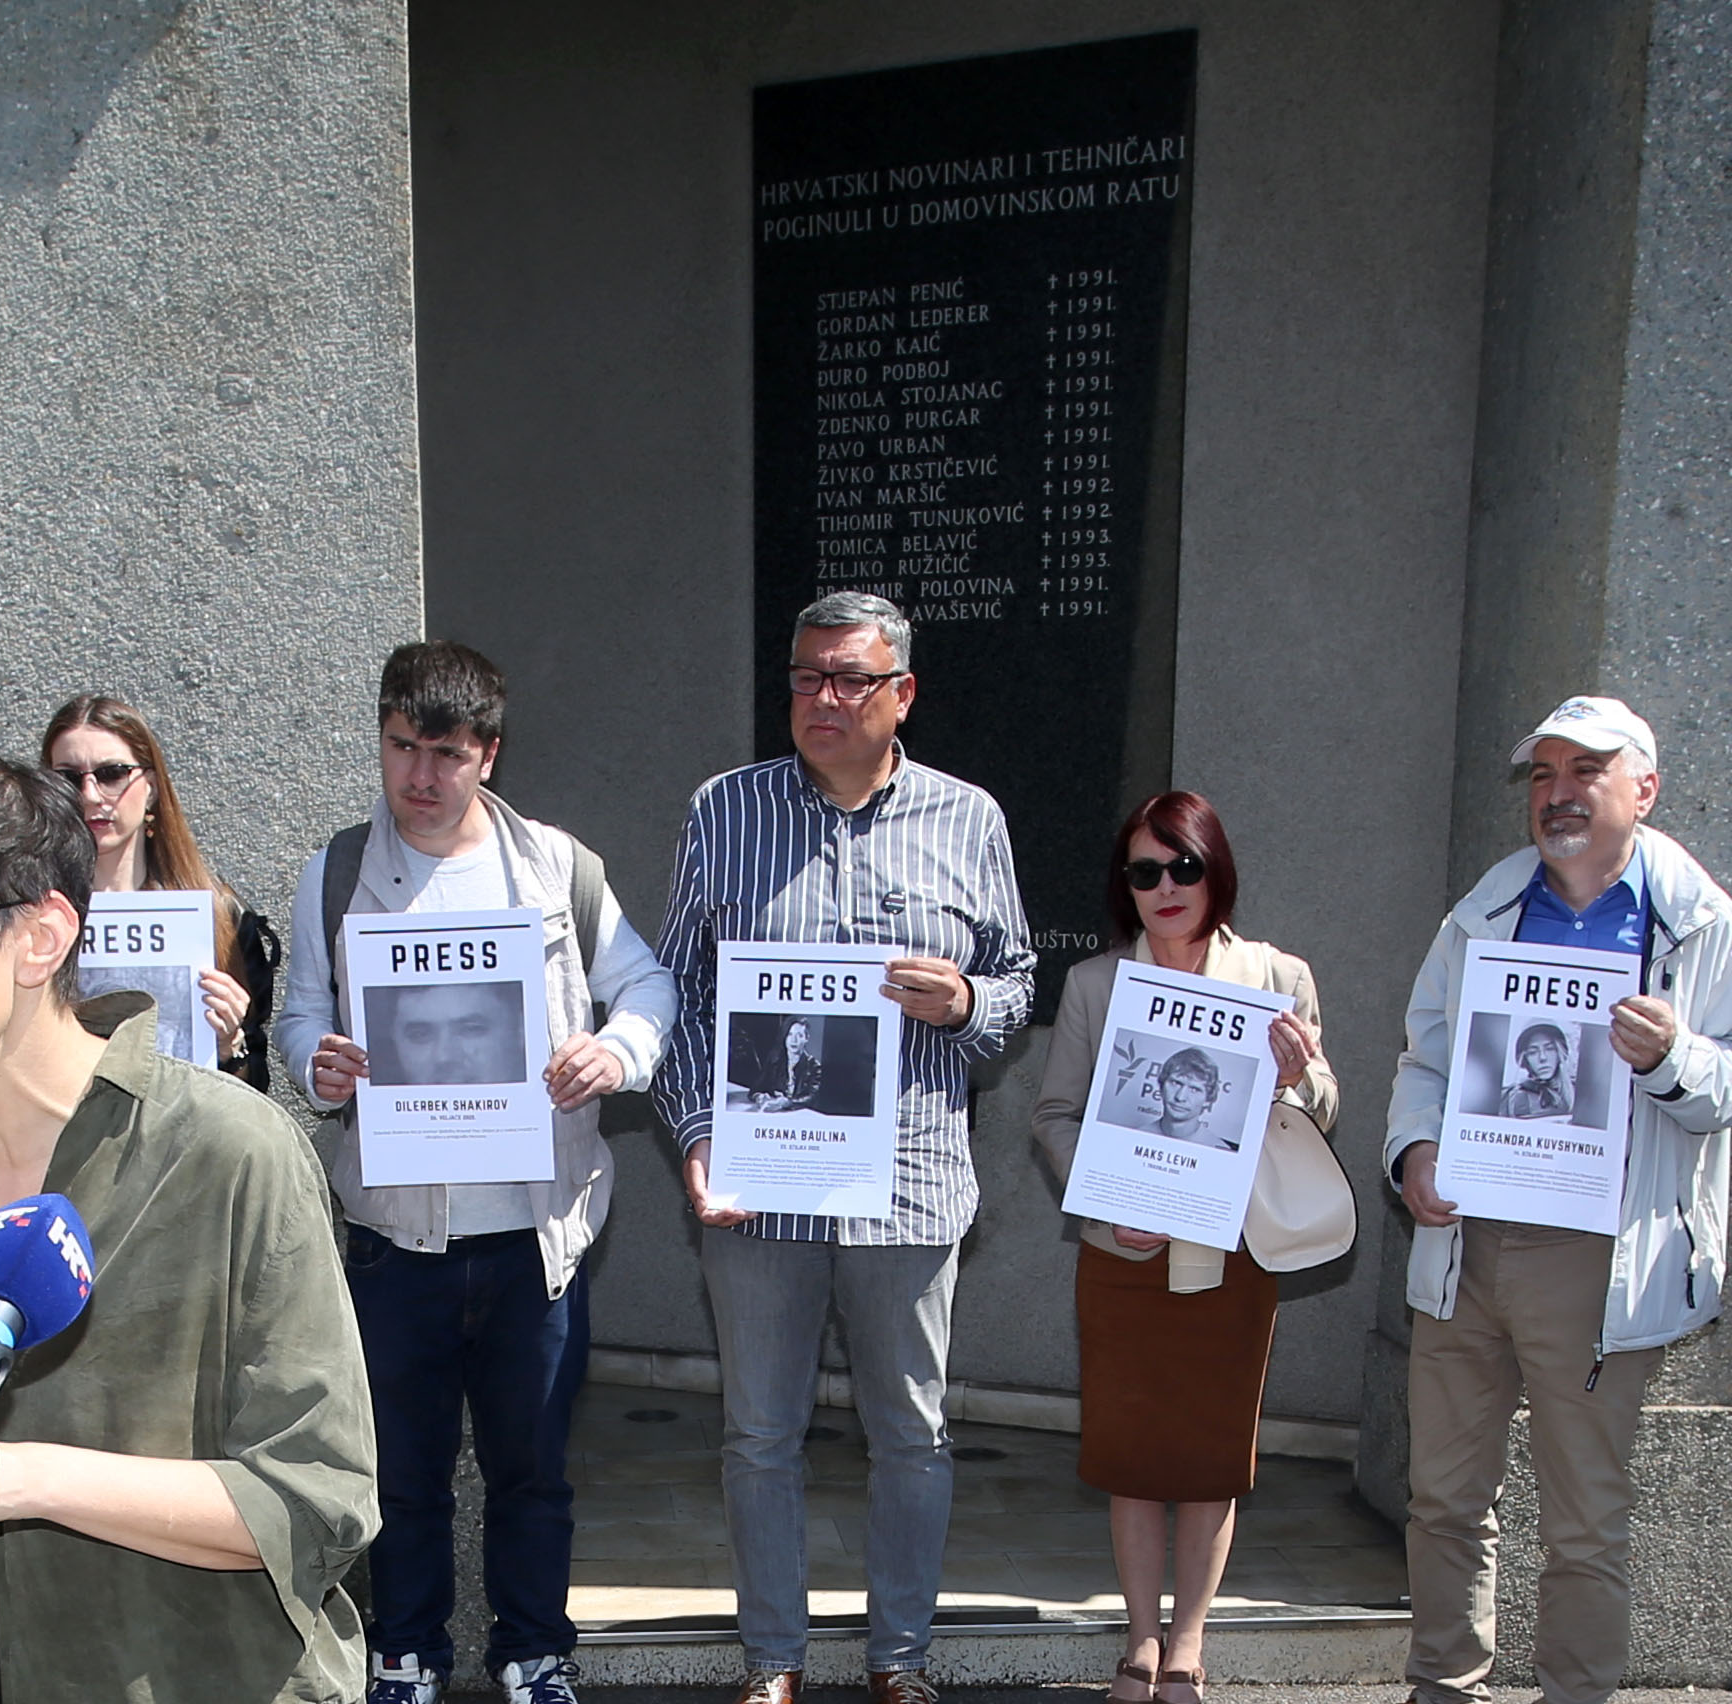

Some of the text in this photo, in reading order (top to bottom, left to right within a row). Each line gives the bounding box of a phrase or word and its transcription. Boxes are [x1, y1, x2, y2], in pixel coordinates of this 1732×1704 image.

[761, 134, 1186, 206] HRVATSKI NOVINARI I TEHNIČARI
[763, 173, 1180, 242] POGINULI U DOMOVINSKOM RATU
[817, 287, 896, 311] STJEPAN
[911, 276, 965, 302] PENIĆ
[817, 312, 895, 336] GORDAN
[910, 304, 989, 329] LEDERER
[818, 340, 882, 362] ŽARKO
[896, 330, 941, 355] KAIĆ
[818, 367, 868, 387] ĐURO
[882, 360, 950, 382] PODBOJ
[818, 391, 886, 411] NIKOLA
[900, 381, 1004, 406] STOJANAC
[818, 414, 890, 436] ZDENKO
[905, 407, 981, 429] PURGAR
[818, 441, 865, 460] PAVO
[879, 435, 946, 456] URBAN
[818, 466, 874, 485] ŽIVKO
[889, 454, 997, 482] KRSTIČEVIĆ
[817, 490, 863, 509] IVAN
[877, 481, 947, 505] MARŠIĆ
[817, 513, 894, 533] TIHOMIR
[909, 501, 1025, 528] TUNUKOVIĆ
[817, 538, 887, 557] TOMICA
[902, 529, 978, 553] BELAVIĆ
[818, 560, 884, 579] ŽELJKO
[898, 553, 971, 576] RUŽIČIĆ
[920, 577, 1016, 598] POLOVINA
[81, 923, 165, 954] RESS
[1035, 930, 1098, 950] UŠTVO
[391, 940, 497, 973] PRESS
[758, 972, 858, 1002] PRESS
[1504, 973, 1600, 1011] PRESS
[1148, 996, 1247, 1041] PRESS
[395, 1098, 508, 1112] DILERBEK SHAKIROV
[754, 1128, 847, 1143] OKSANA BAULINA
[1459, 1129, 1605, 1157] OLEKSANDRA KUVSHYNOVA
[1134, 1146, 1164, 1162] MAKS
[1166, 1152, 1198, 1169] LEVIN
